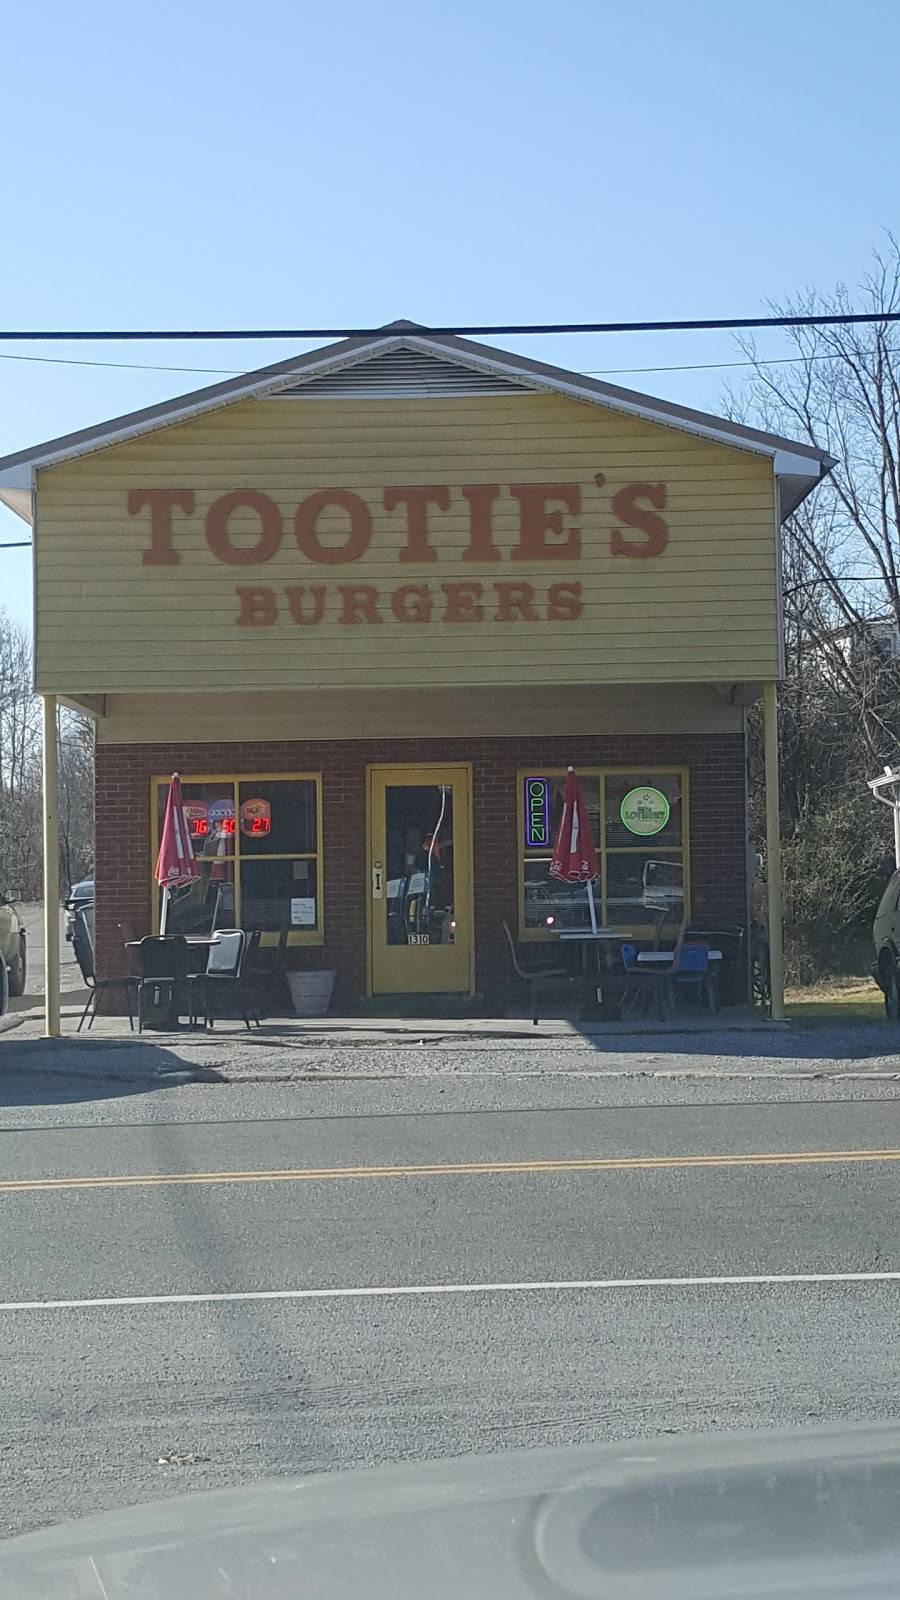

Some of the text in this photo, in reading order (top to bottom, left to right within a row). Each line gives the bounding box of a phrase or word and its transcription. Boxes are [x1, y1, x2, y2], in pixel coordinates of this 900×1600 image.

[128, 473, 670, 566] TOOTIE'S
[236, 582, 583, 627] BURGERS
[529, 782, 545, 842] OPEN
[409, 935, 429, 944] 1310
